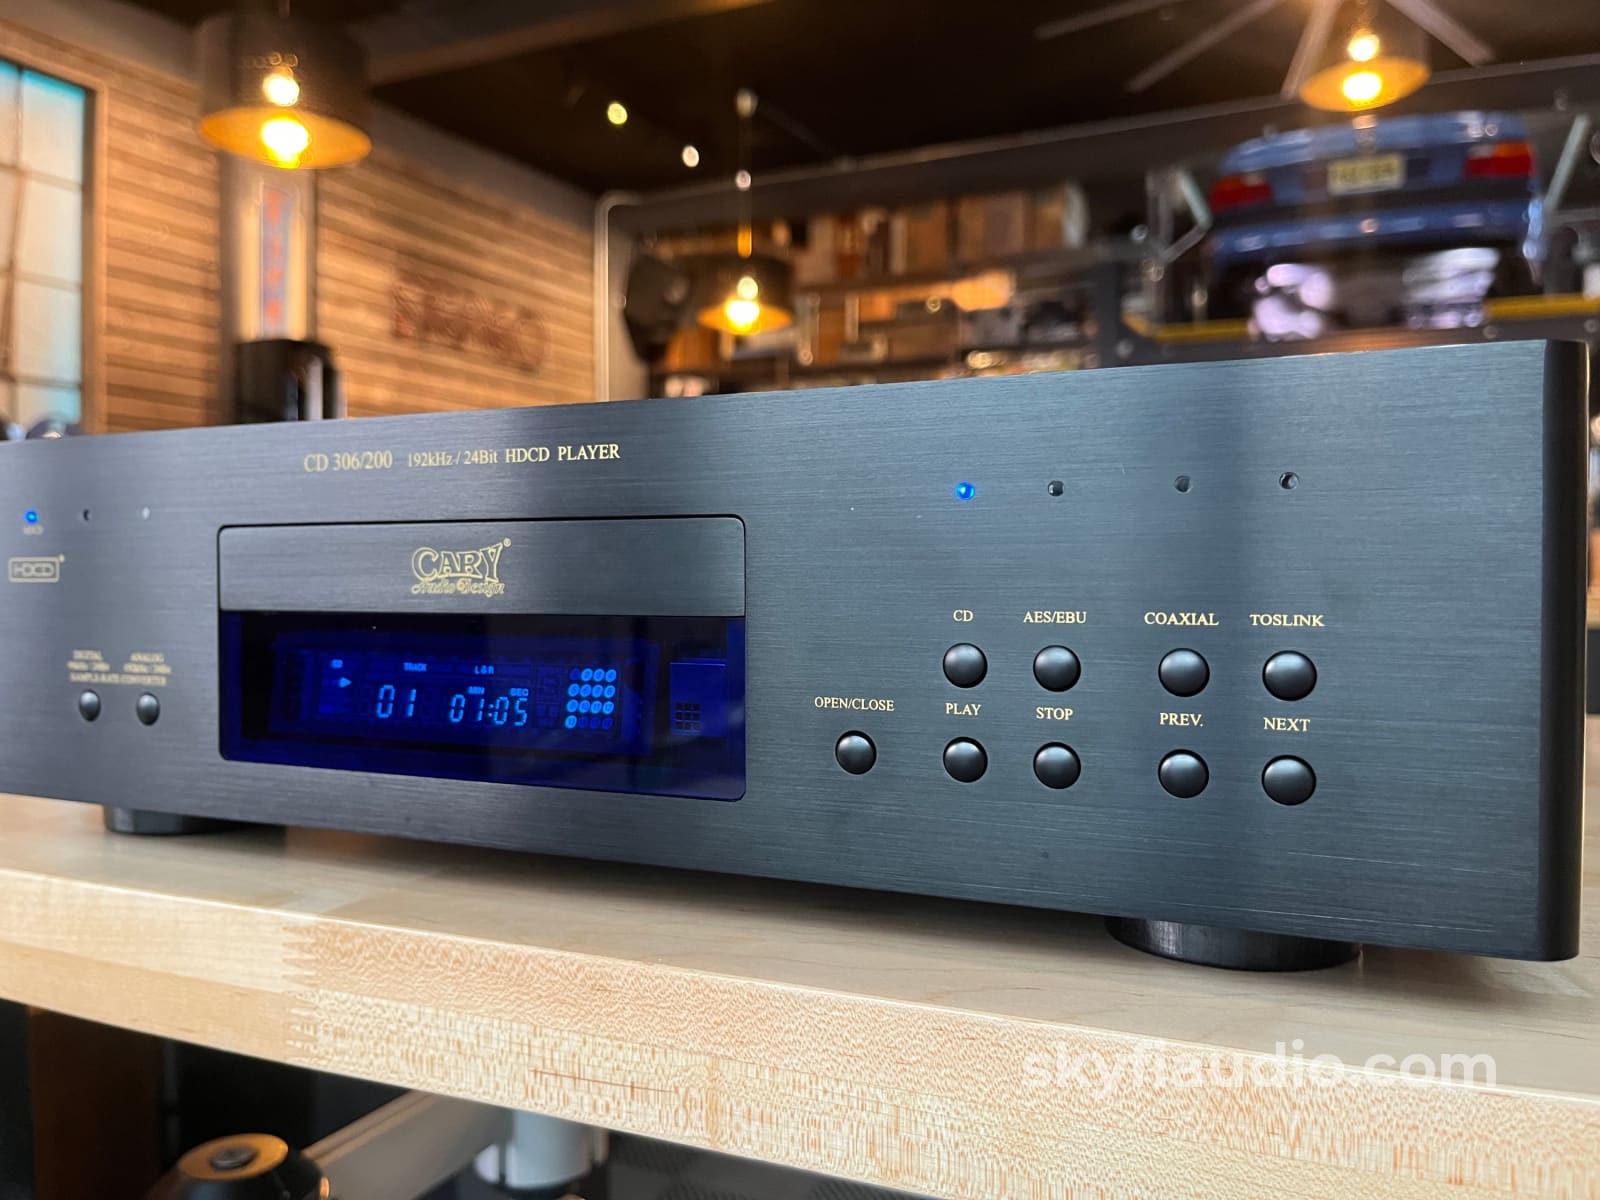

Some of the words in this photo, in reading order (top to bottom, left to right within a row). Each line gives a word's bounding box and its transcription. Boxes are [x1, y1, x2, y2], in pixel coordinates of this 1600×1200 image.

[303, 453, 329, 472] CD
[332, 450, 393, 471] 306/200
[408, 451, 454, 468] 192kHz
[464, 449, 498, 465] 24Bit
[505, 447, 550, 463] HDCD
[557, 443, 621, 461] PLAYER
[952, 609, 974, 622] CD
[1023, 611, 1087, 624] AES/EBU
[1143, 611, 1220, 627] COAXIAL
[1249, 614, 1325, 627] TOSLINK
[376, 684, 417, 718] 01
[814, 696, 895, 712] OPEN/CLOSE
[450, 694, 528, 726] 01:05
[945, 702, 982, 716] PLAY
[1035, 706, 1074, 721] STOP
[1159, 712, 1204, 727] PREV.
[1263, 717, 1311, 732] NEXT
